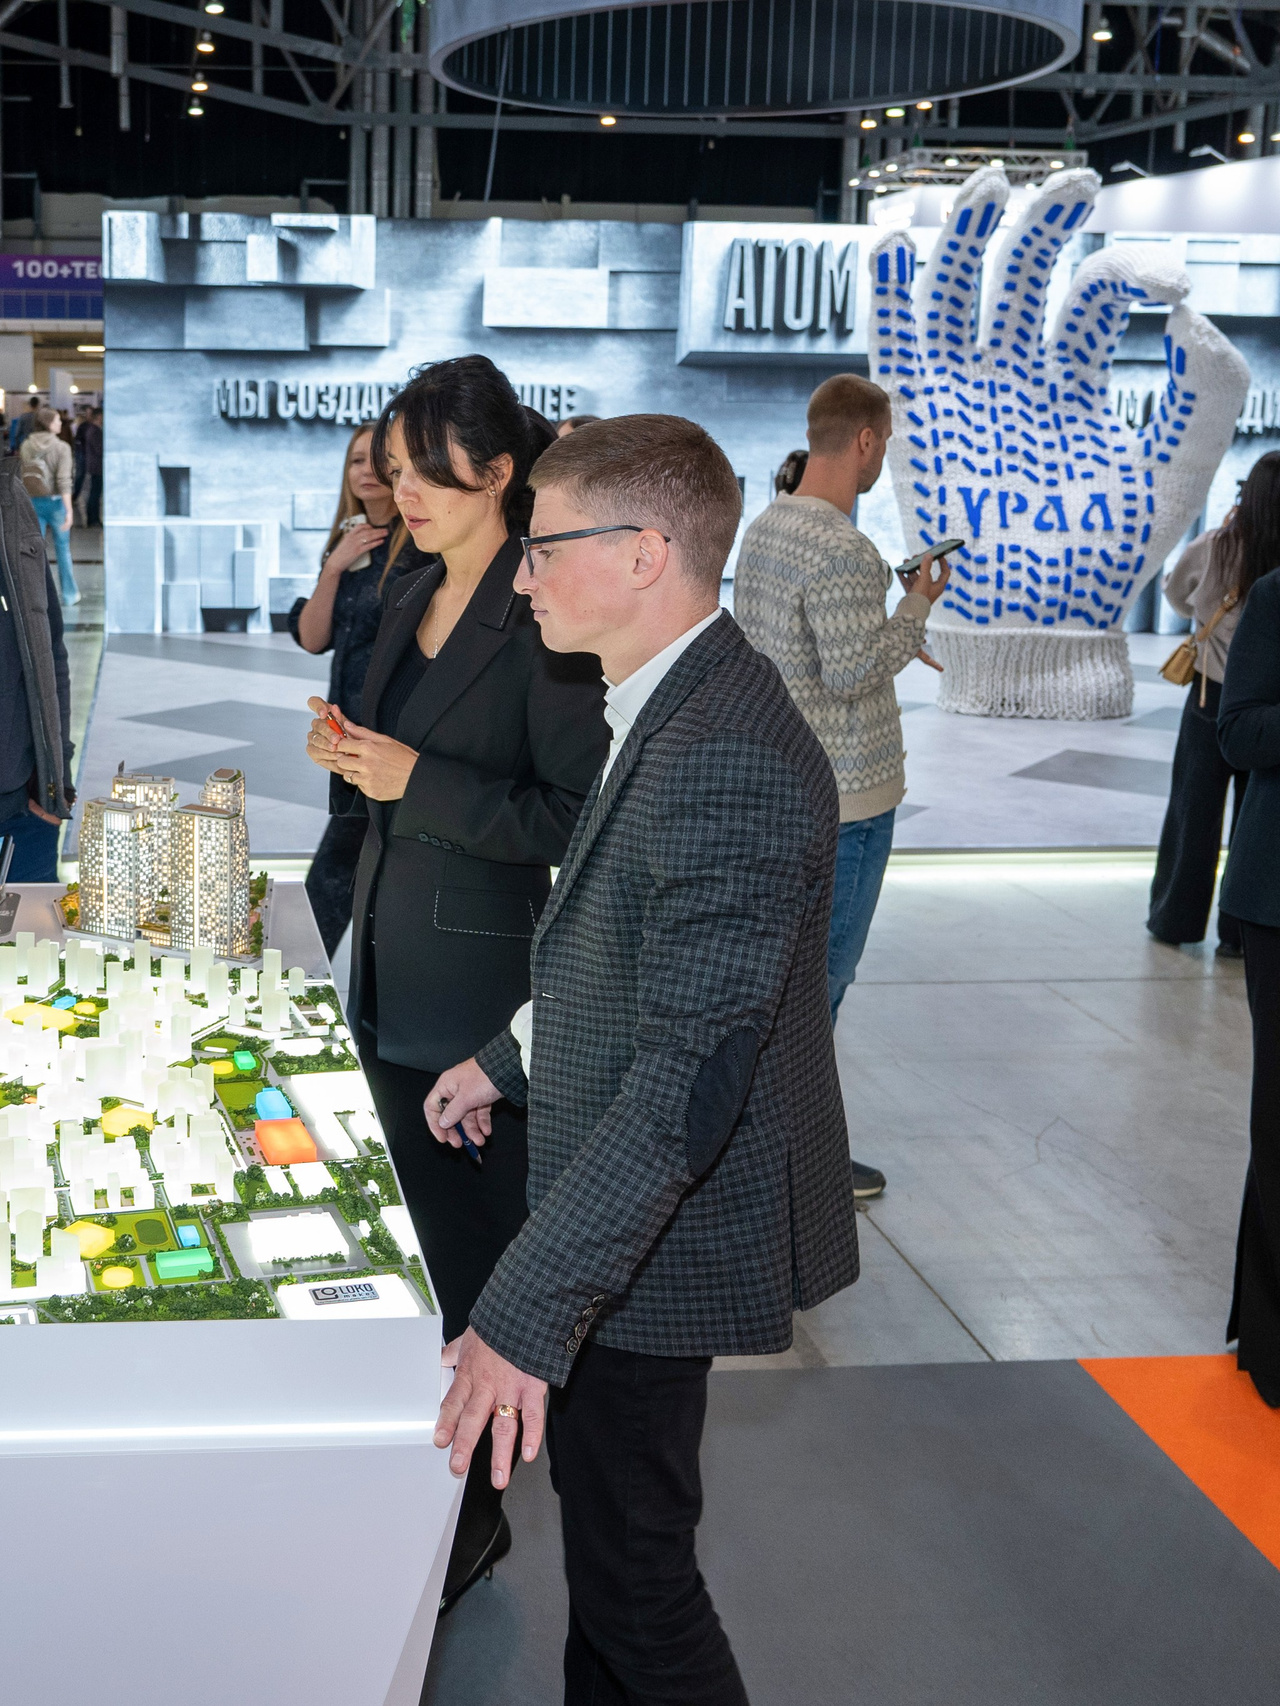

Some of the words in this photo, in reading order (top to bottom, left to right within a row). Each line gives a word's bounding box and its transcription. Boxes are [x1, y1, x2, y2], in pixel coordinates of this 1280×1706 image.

[723, 238, 859, 332] АТОМ
[211, 378, 269, 419] МЫ
[339, 1283, 373, 1295] LOKO
